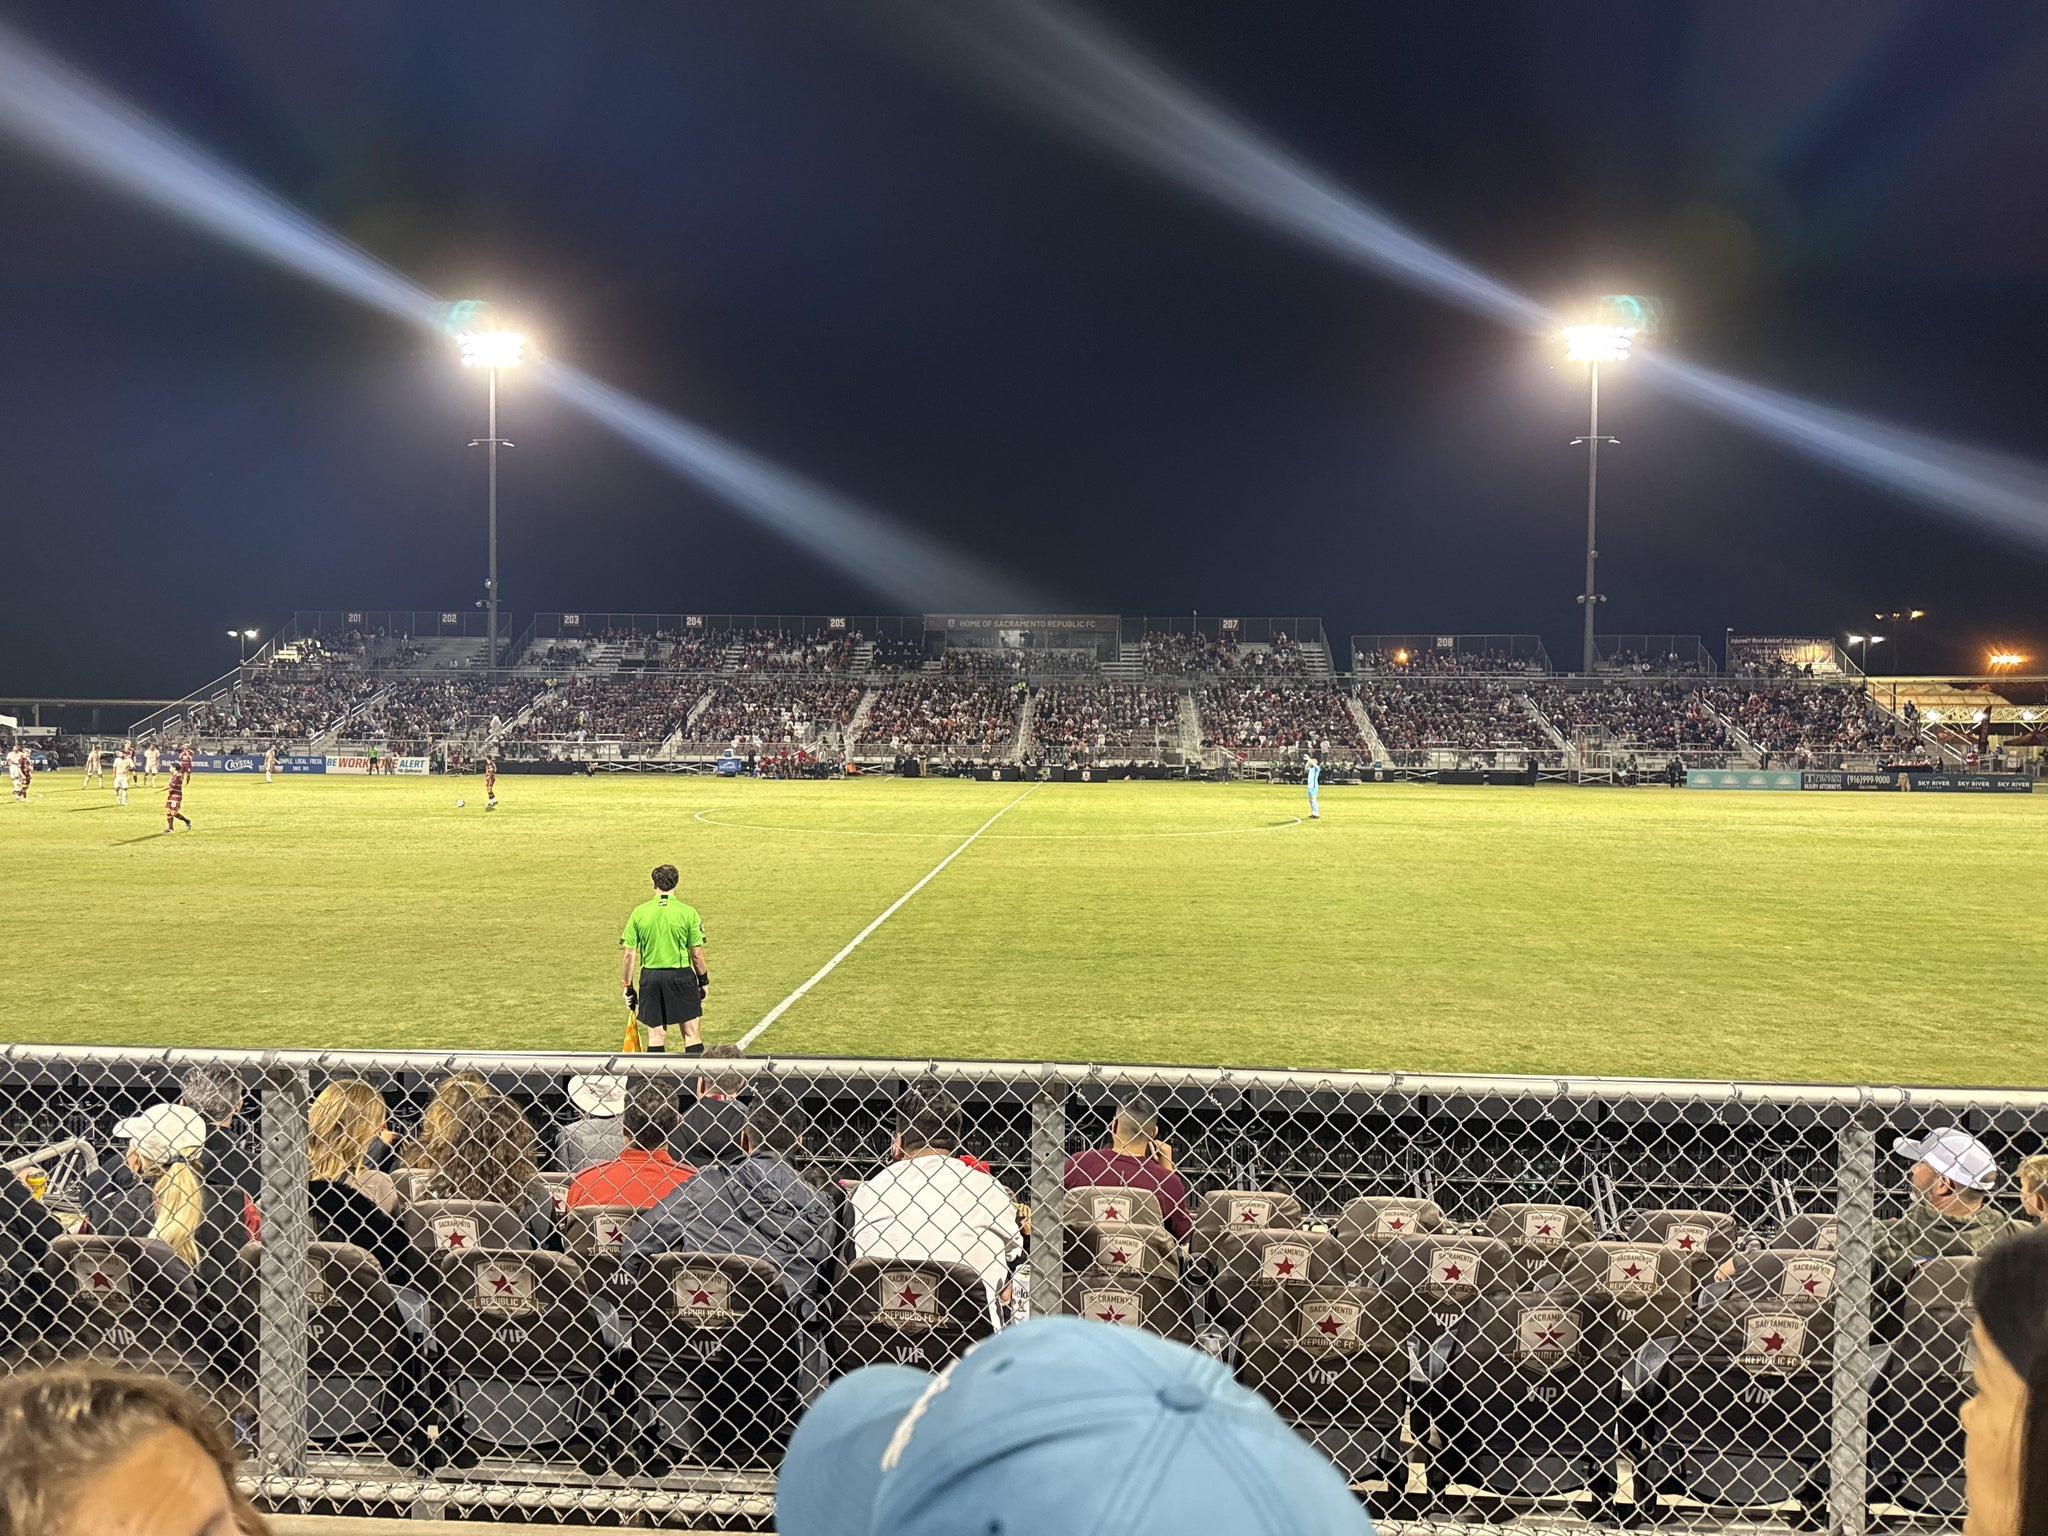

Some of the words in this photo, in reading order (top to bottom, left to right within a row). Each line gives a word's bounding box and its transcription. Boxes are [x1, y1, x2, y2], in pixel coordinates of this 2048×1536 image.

[348, 613, 361, 622] 201
[442, 613, 457, 623] 202
[564, 615, 579, 624] 203
[686, 616, 702, 626] 204
[830, 618, 845, 628] 205
[960, 620, 981, 628] HOME
[983, 620, 992, 628] OF
[993, 620, 1046, 628] SACRAMENTO
[1047, 620, 1085, 628] REPUBLIC
[1086, 620, 1096, 628] FC
[1222, 619, 1238, 629] 207
[1437, 637, 1453, 647] 208
[327, 758, 337, 767] BE
[338, 757, 369, 768] WORK
[399, 759, 425, 768] ALERT
[1847, 775, 1891, 785] (916)999-9000
[1104, 1238, 1138, 1248] SRAMENTO
[1524, 1237, 1552, 1245] RPUBLIC
[1270, 1248, 1304, 1258] SAAMENTO
[1439, 1252, 1473, 1263] SARAMENTO
[1526, 1258, 1547, 1270] VIP
[1793, 1263, 1831, 1275] SACRAMNTO
[1644, 1283, 1653, 1291] FC
[314, 1294, 325, 1302] FC
[1089, 1294, 1133, 1306] SCRAMENTO
[924, 1314, 934, 1323] FC
[1435, 1312, 1459, 1326] VIP
[496, 1328, 526, 1343] VIP
[1301, 1338, 1342, 1347] REPUBIC
[1343, 1340, 1355, 1349] FC
[895, 1345, 925, 1364] VIP
[1520, 1351, 1561, 1361] RPUBLIC
[1745, 1355, 1786, 1365] REPULIC
[1787, 1357, 1797, 1366] FC
[1308, 1369, 1338, 1385] VIP
[1526, 1386, 1557, 1403] VIP
